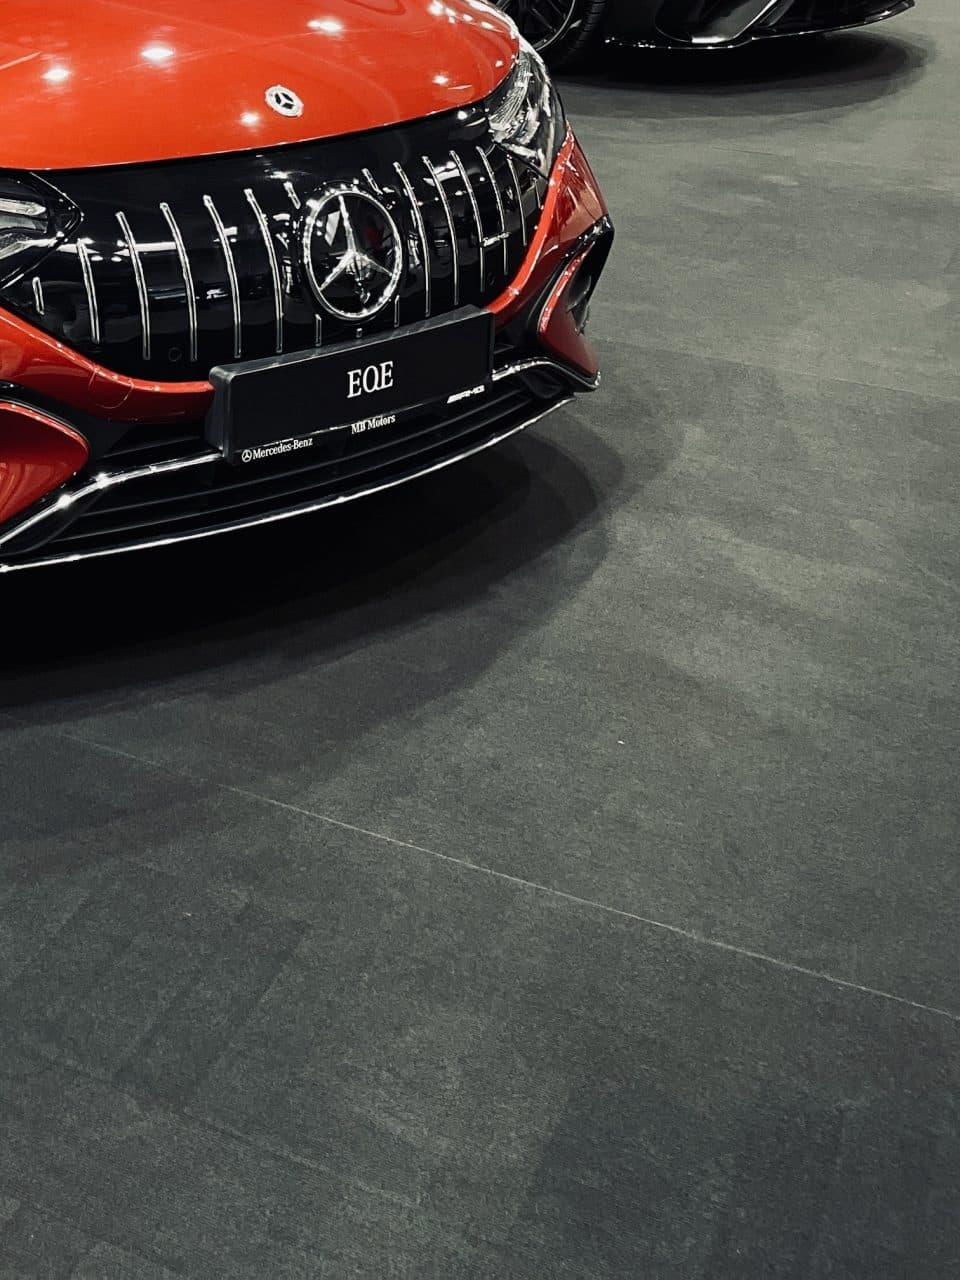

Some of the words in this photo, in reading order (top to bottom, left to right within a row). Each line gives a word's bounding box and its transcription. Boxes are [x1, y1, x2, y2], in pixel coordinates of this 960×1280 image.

[346, 360, 395, 399] EQE
[368, 414, 396, 431] Motors
[251, 437, 314, 460] Mercedes-Benz
